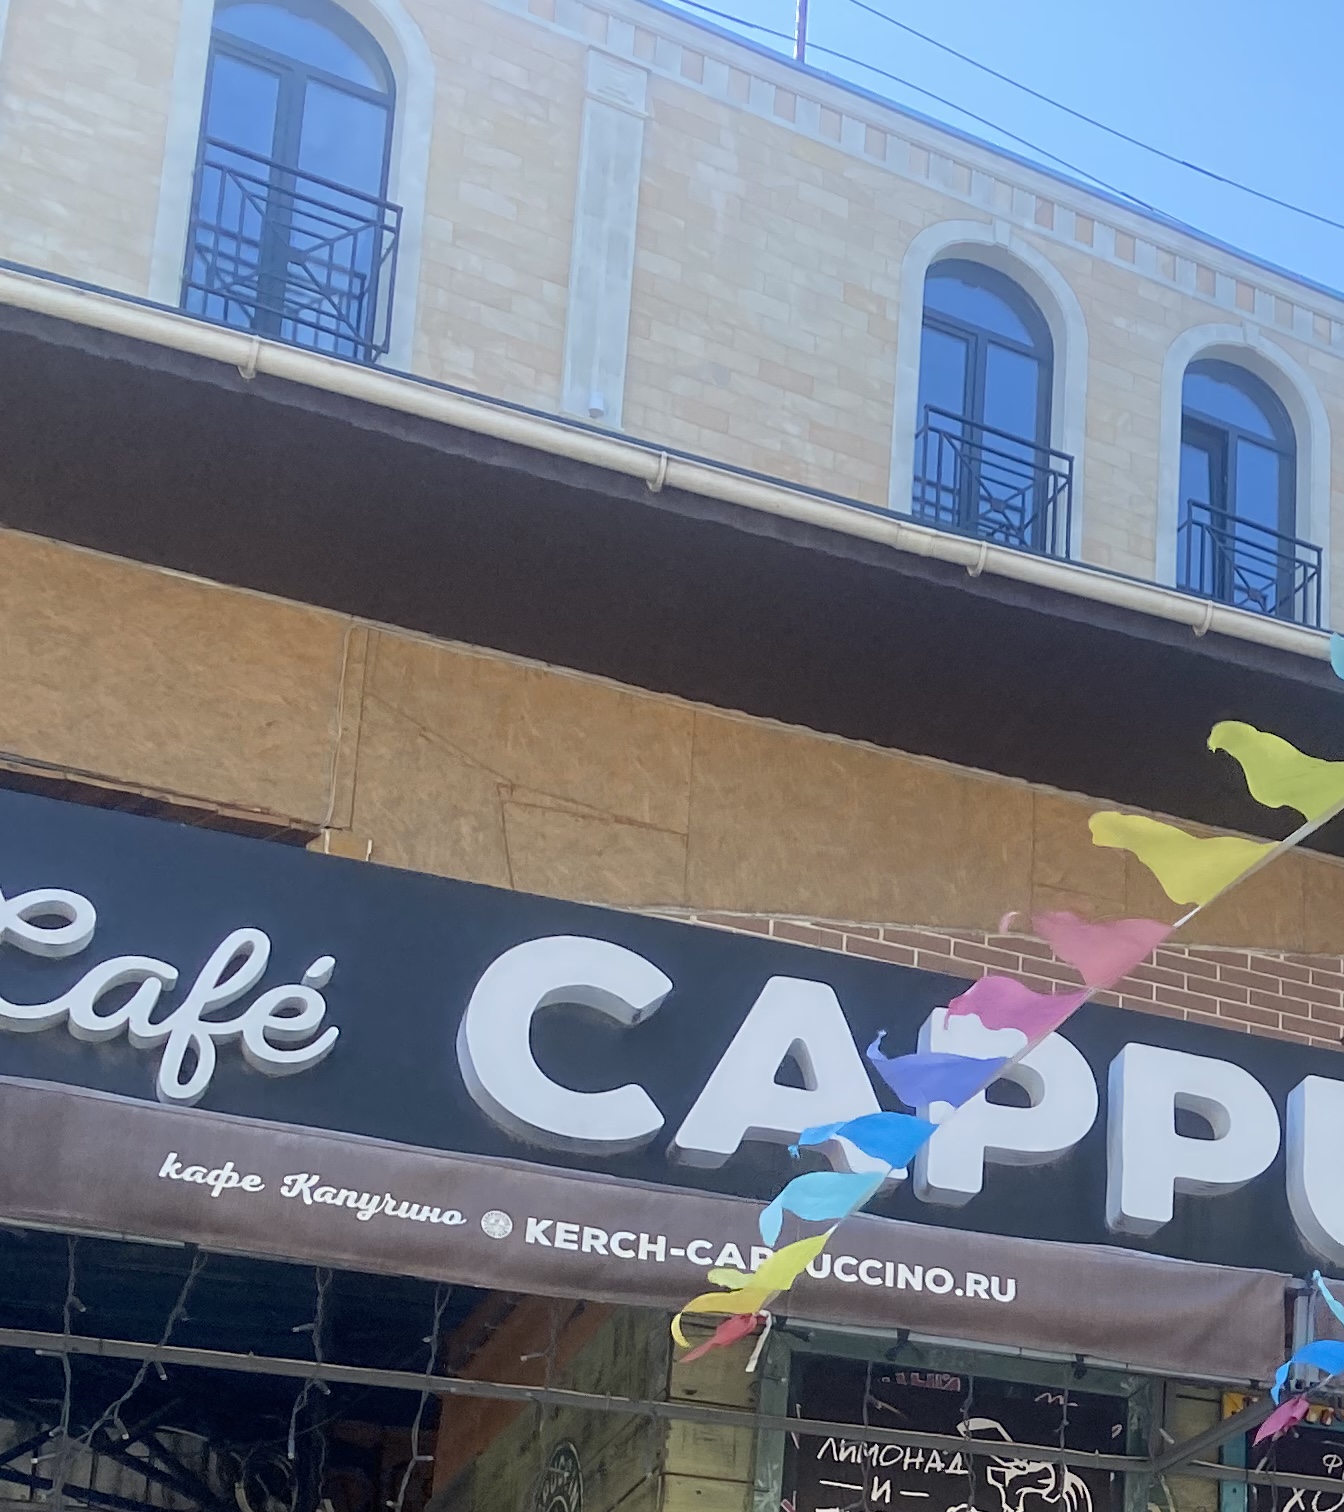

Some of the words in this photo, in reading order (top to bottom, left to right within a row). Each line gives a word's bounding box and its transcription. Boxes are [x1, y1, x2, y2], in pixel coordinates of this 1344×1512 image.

[0, 886, 340, 1103] Café
[159, 1152, 265, 1197] кафе
[281, 1173, 467, 1226] Капучино
[526, 1217, 1016, 1302] KERCH-CAPUCCINO.RU
[816, 1437, 969, 1475] ЛИМОНАД
